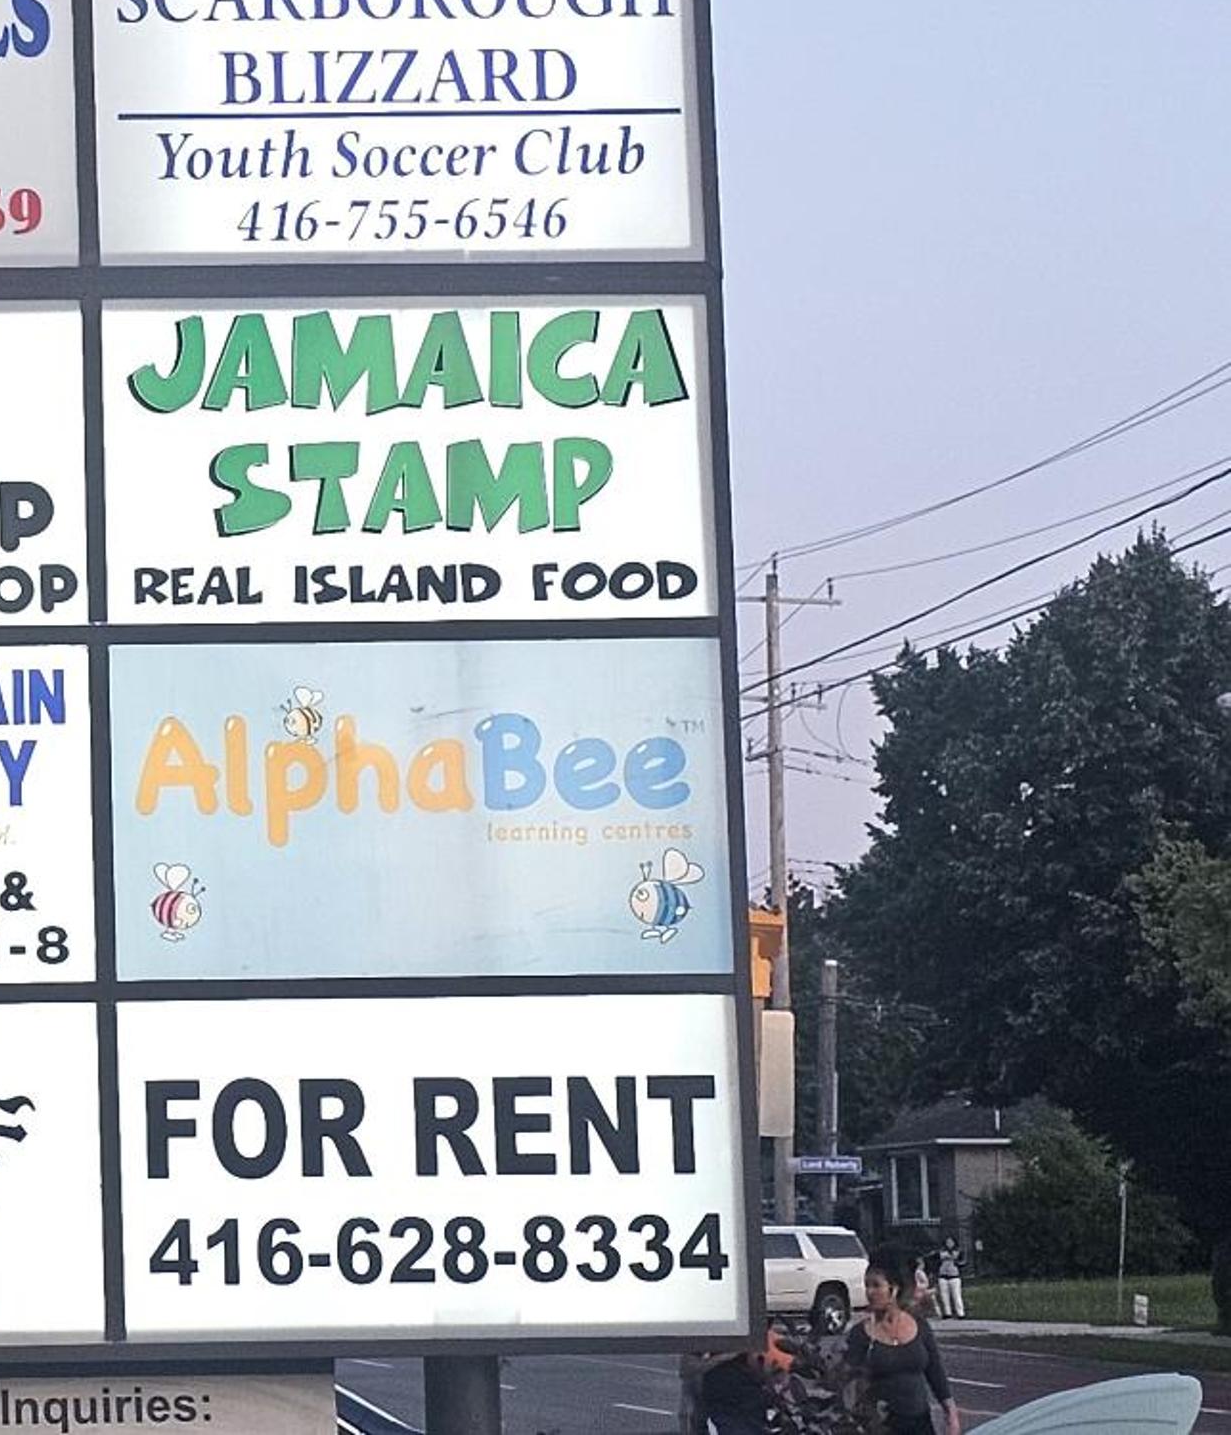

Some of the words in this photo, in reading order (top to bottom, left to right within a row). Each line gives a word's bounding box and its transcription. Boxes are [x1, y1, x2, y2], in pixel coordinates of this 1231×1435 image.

[219, 48, 578, 106] BLIZZARD
[157, 128, 313, 181] Youth
[330, 130, 497, 179] Soccer
[514, 125, 646, 176] Club
[236, 196, 569, 242] 416-755-6546
[126, 308, 689, 416] JAMAICA
[208, 436, 614, 538] STAMP
[133, 565, 263, 605] REAL
[293, 562, 502, 605] ISLAND
[532, 560, 699, 602] FOOD
[135, 712, 692, 848] AlphaBee
[487, 821, 589, 845] learning
[602, 821, 694, 841] centres
[144, 1076, 374, 1180] FOR
[411, 1074, 716, 1177] RENT
[148, 1212, 730, 1286] 416-628-8334
[1, 1387, 211, 1433] Inquiries:
